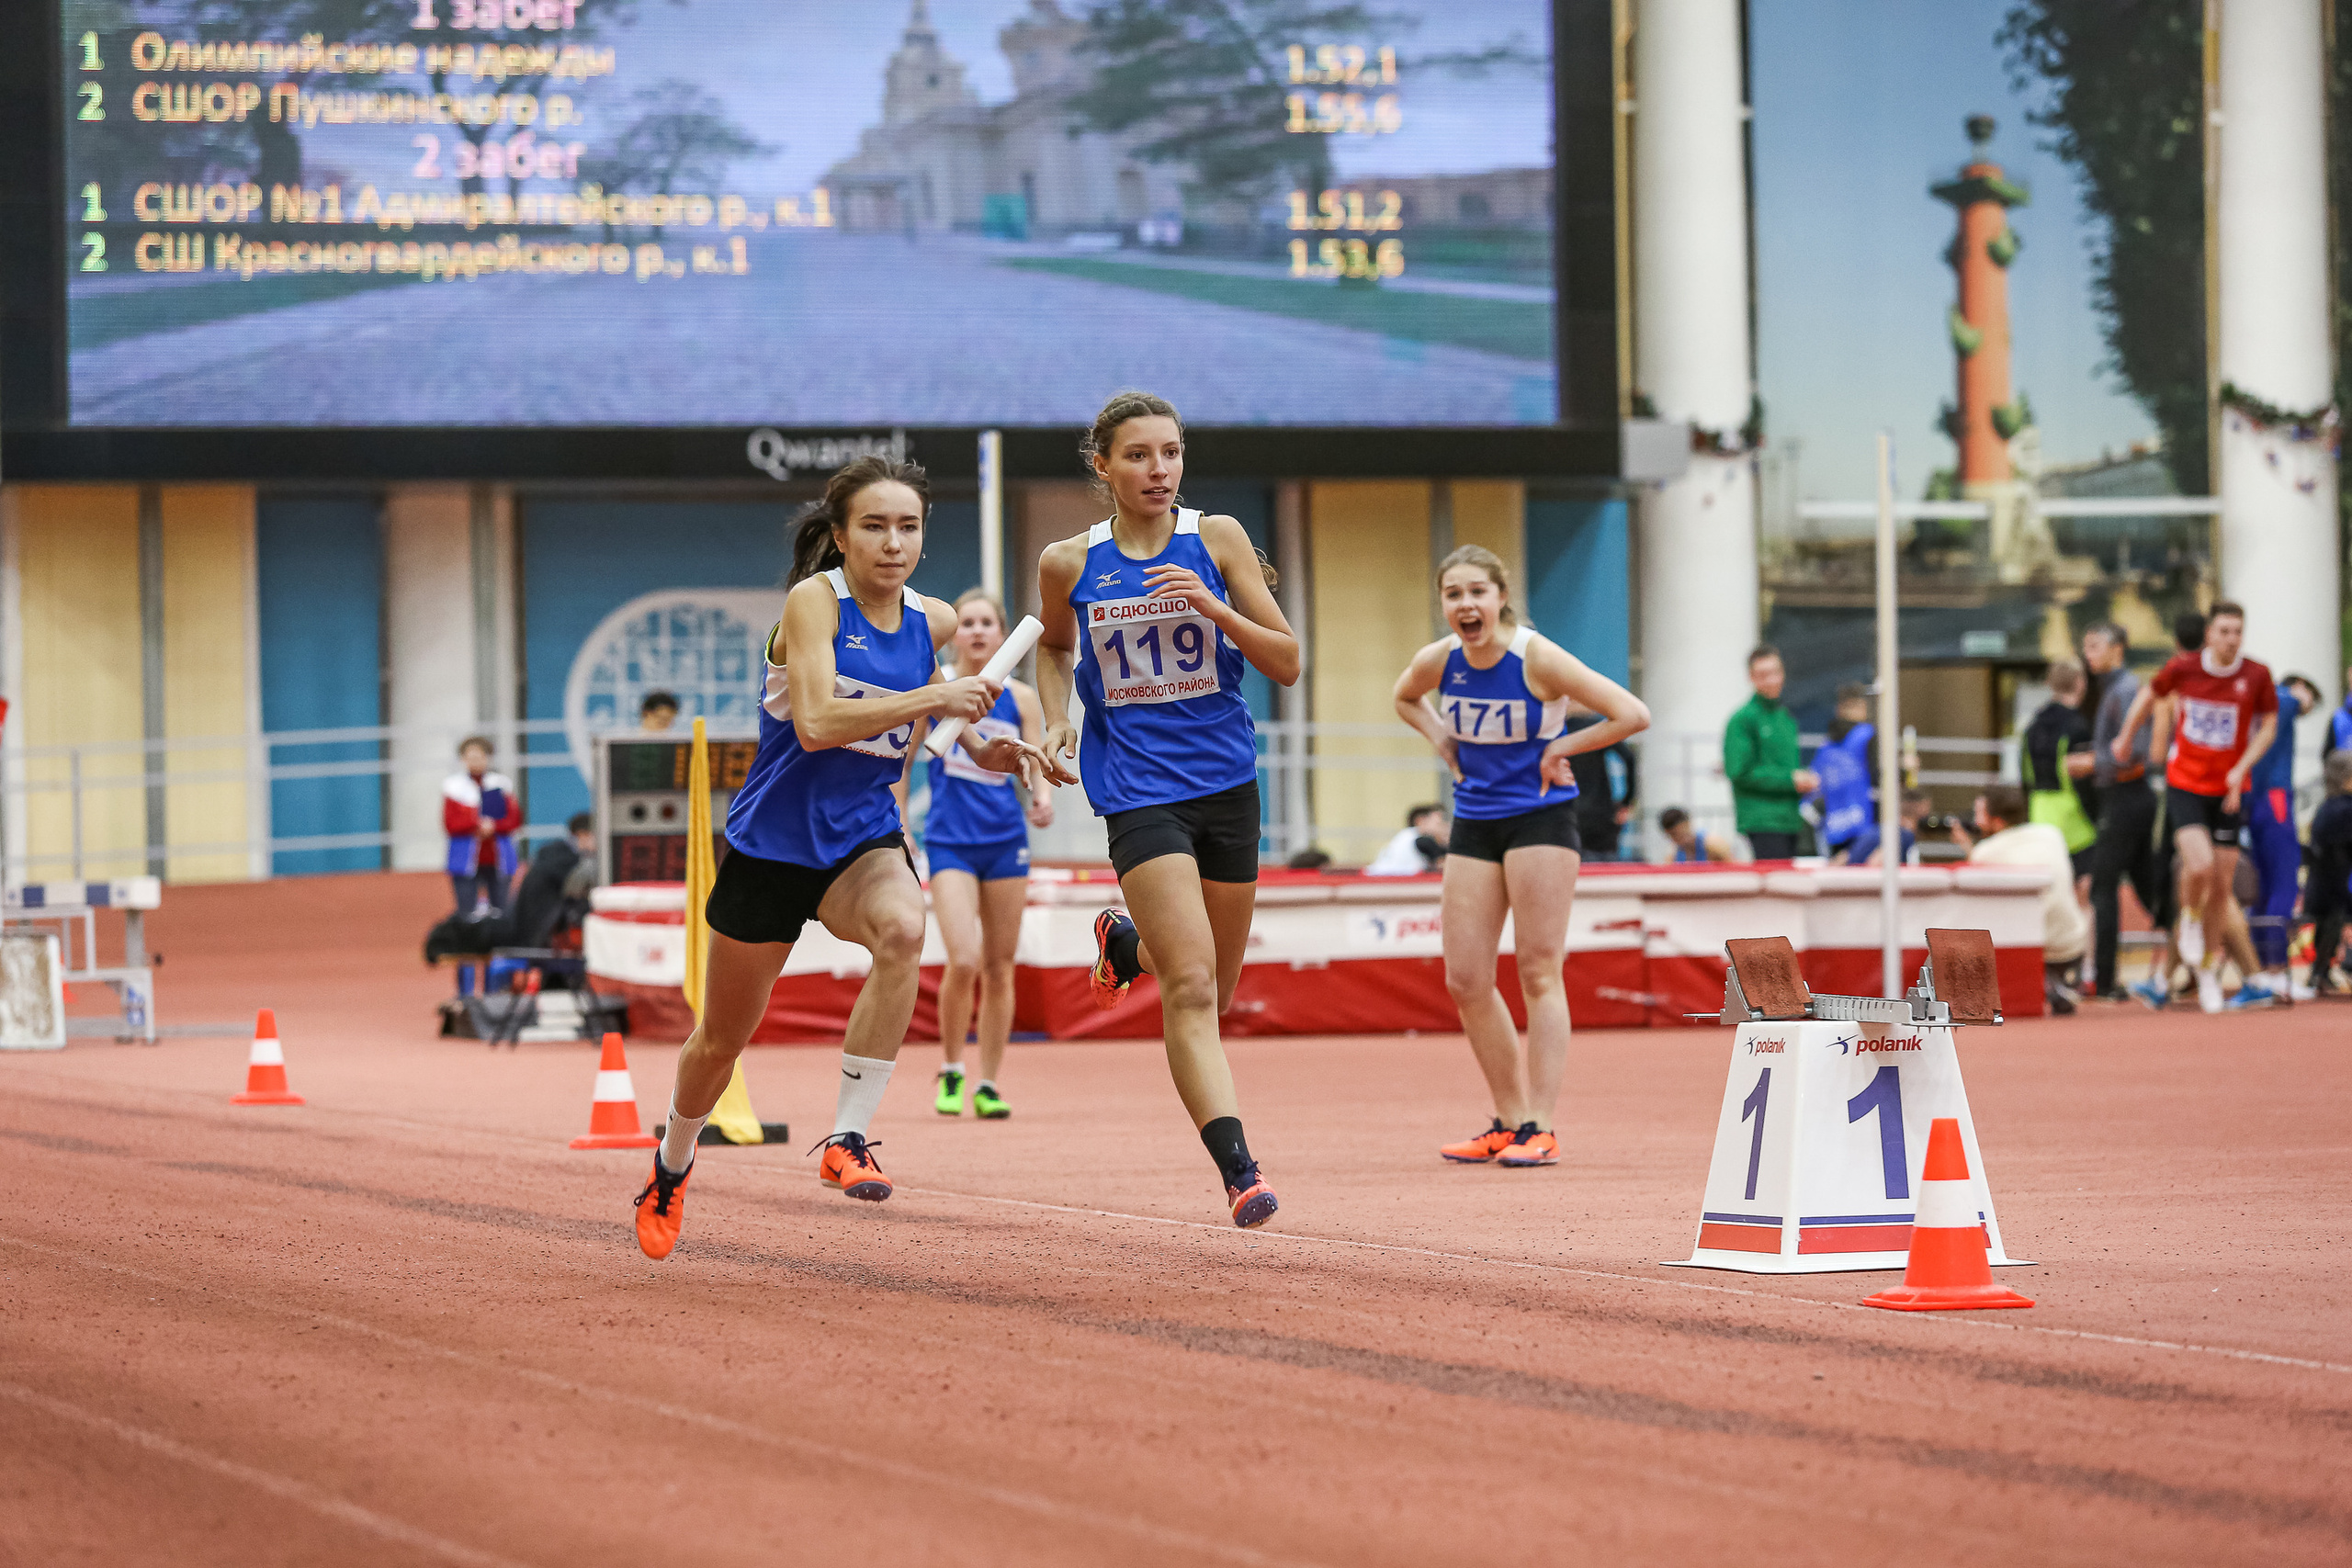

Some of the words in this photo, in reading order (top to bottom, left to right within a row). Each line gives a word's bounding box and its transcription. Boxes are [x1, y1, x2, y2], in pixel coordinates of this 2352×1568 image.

[412, 0, 440, 30] 1
[449, 0, 584, 31] забег
[78, 30, 105, 72] 1
[130, 30, 419, 74] Олимпийские
[424, 42, 616, 85] надежды
[77, 81, 107, 122] 2
[131, 81, 261, 123] СШОР
[268, 82, 539, 130] Пушкинского
[545, 93, 584, 131] р.
[412, 133, 443, 179] 2
[454, 130, 588, 180] забег
[81, 181, 107, 222] 1
[133, 182, 263, 223] СШОР
[270, 183, 345, 223] №1
[352, 182, 714, 232] Адмиралтейского
[80, 231, 108, 273] 2
[135, 231, 205, 273] СШ
[213, 231, 630, 284] Красногвардейского
[1104, 622, 1204, 680] 119
[1108, 682, 1176, 702] МОСКОВСКОГО
[1179, 676, 1216, 694] РАЙОНА
[1448, 700, 1512, 738] 171
[1755, 1037, 1786, 1056] polanik
[1856, 1034, 1924, 1056] polanik
[1741, 1067, 1771, 1200] 1
[1848, 1066, 1909, 1199] 1
